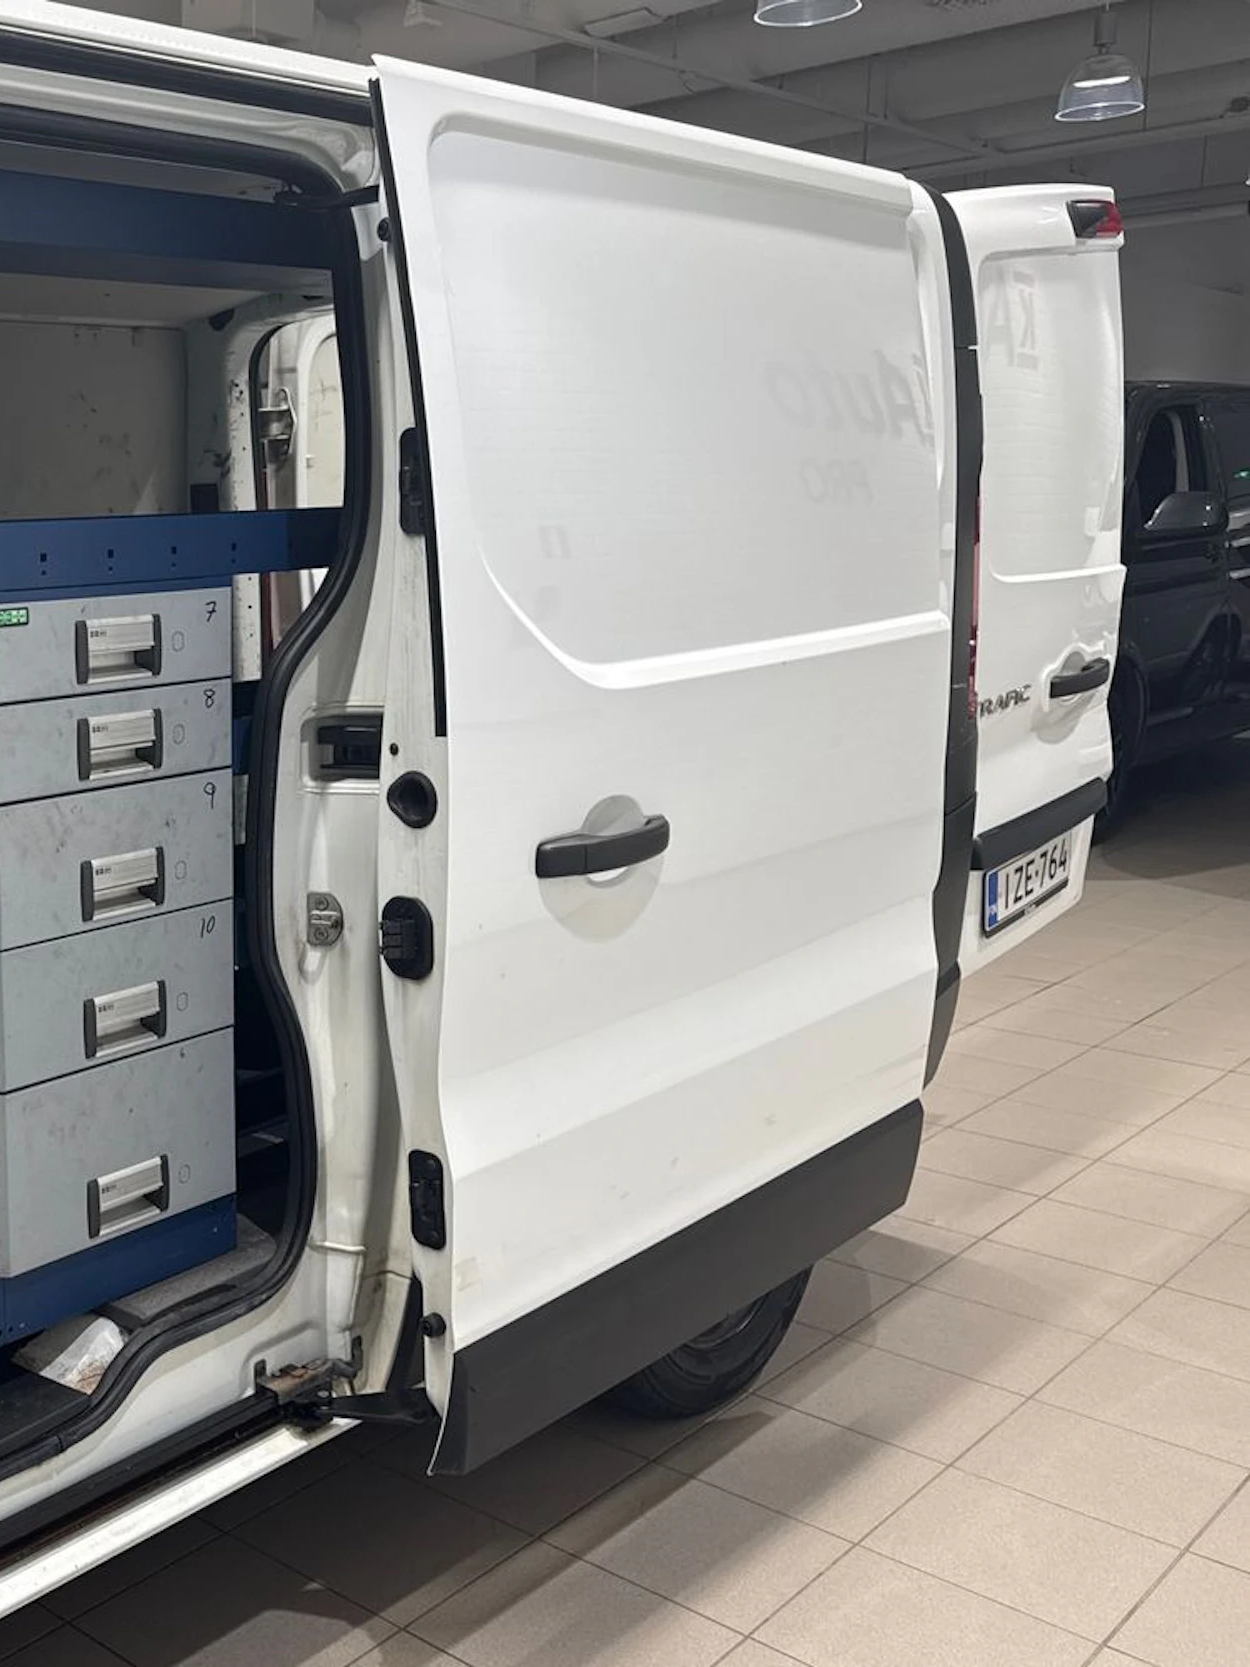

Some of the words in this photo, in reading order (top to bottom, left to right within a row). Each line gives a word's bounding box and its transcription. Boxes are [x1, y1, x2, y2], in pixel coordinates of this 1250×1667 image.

[204, 600, 217, 622] 7
[203, 688, 216, 709] 8
[980, 684, 1031, 718] RAFIC
[203, 781, 217, 810] 9
[1005, 838, 1068, 910] IZE-764
[201, 915, 216, 938] 10
